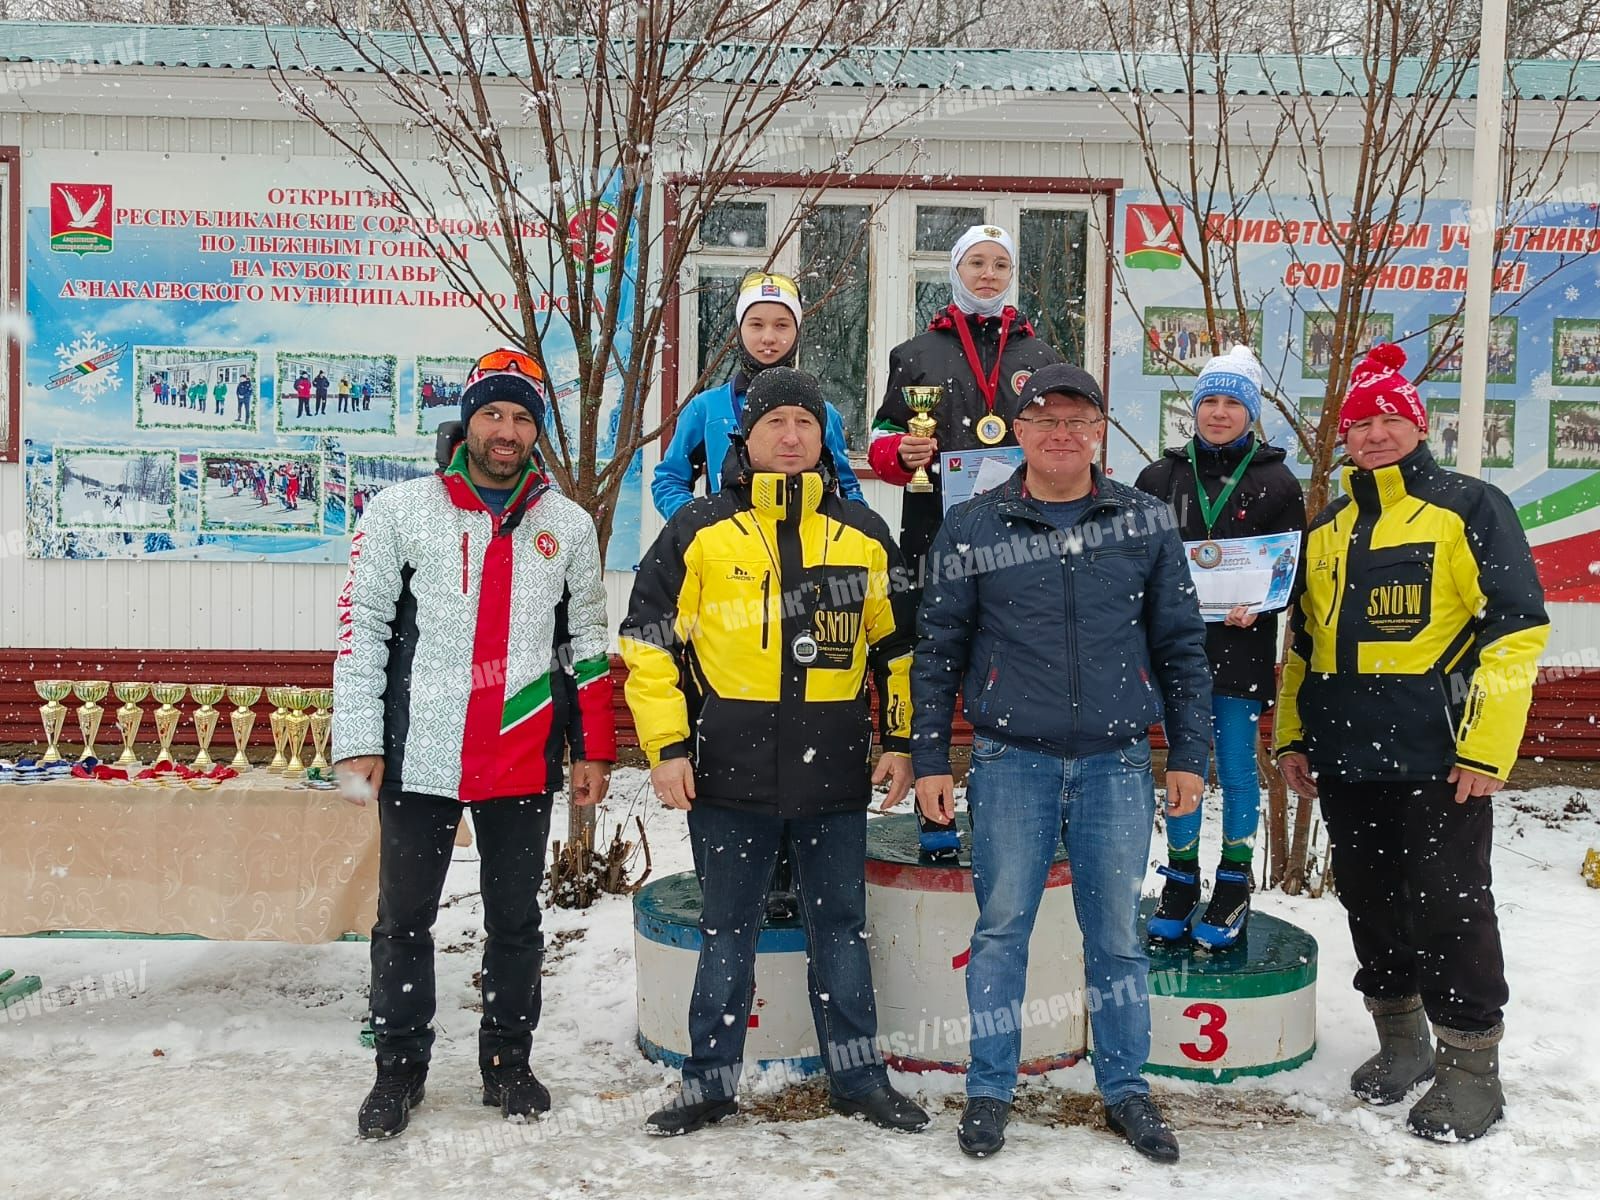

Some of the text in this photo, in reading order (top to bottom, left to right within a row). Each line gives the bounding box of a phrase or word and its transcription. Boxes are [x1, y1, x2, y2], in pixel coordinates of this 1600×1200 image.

[115, 208, 549, 238] РЕСПУБЛИКАНСКИЕ СОРЕВНОВАИЯ
[1204, 213, 1430, 250] Приветстуем
[199, 235, 469, 259] ПО ЛЫЖНЫМ ГОНКАМ
[231, 260, 437, 282] НА КУБОК ГЛАВЫ
[59, 280, 263, 301] АЗНАКАЕВСКОГО
[1367, 585, 1422, 616] SNOW
[815, 610, 859, 643] SNOW
[1179, 1003, 1229, 1062] 3
